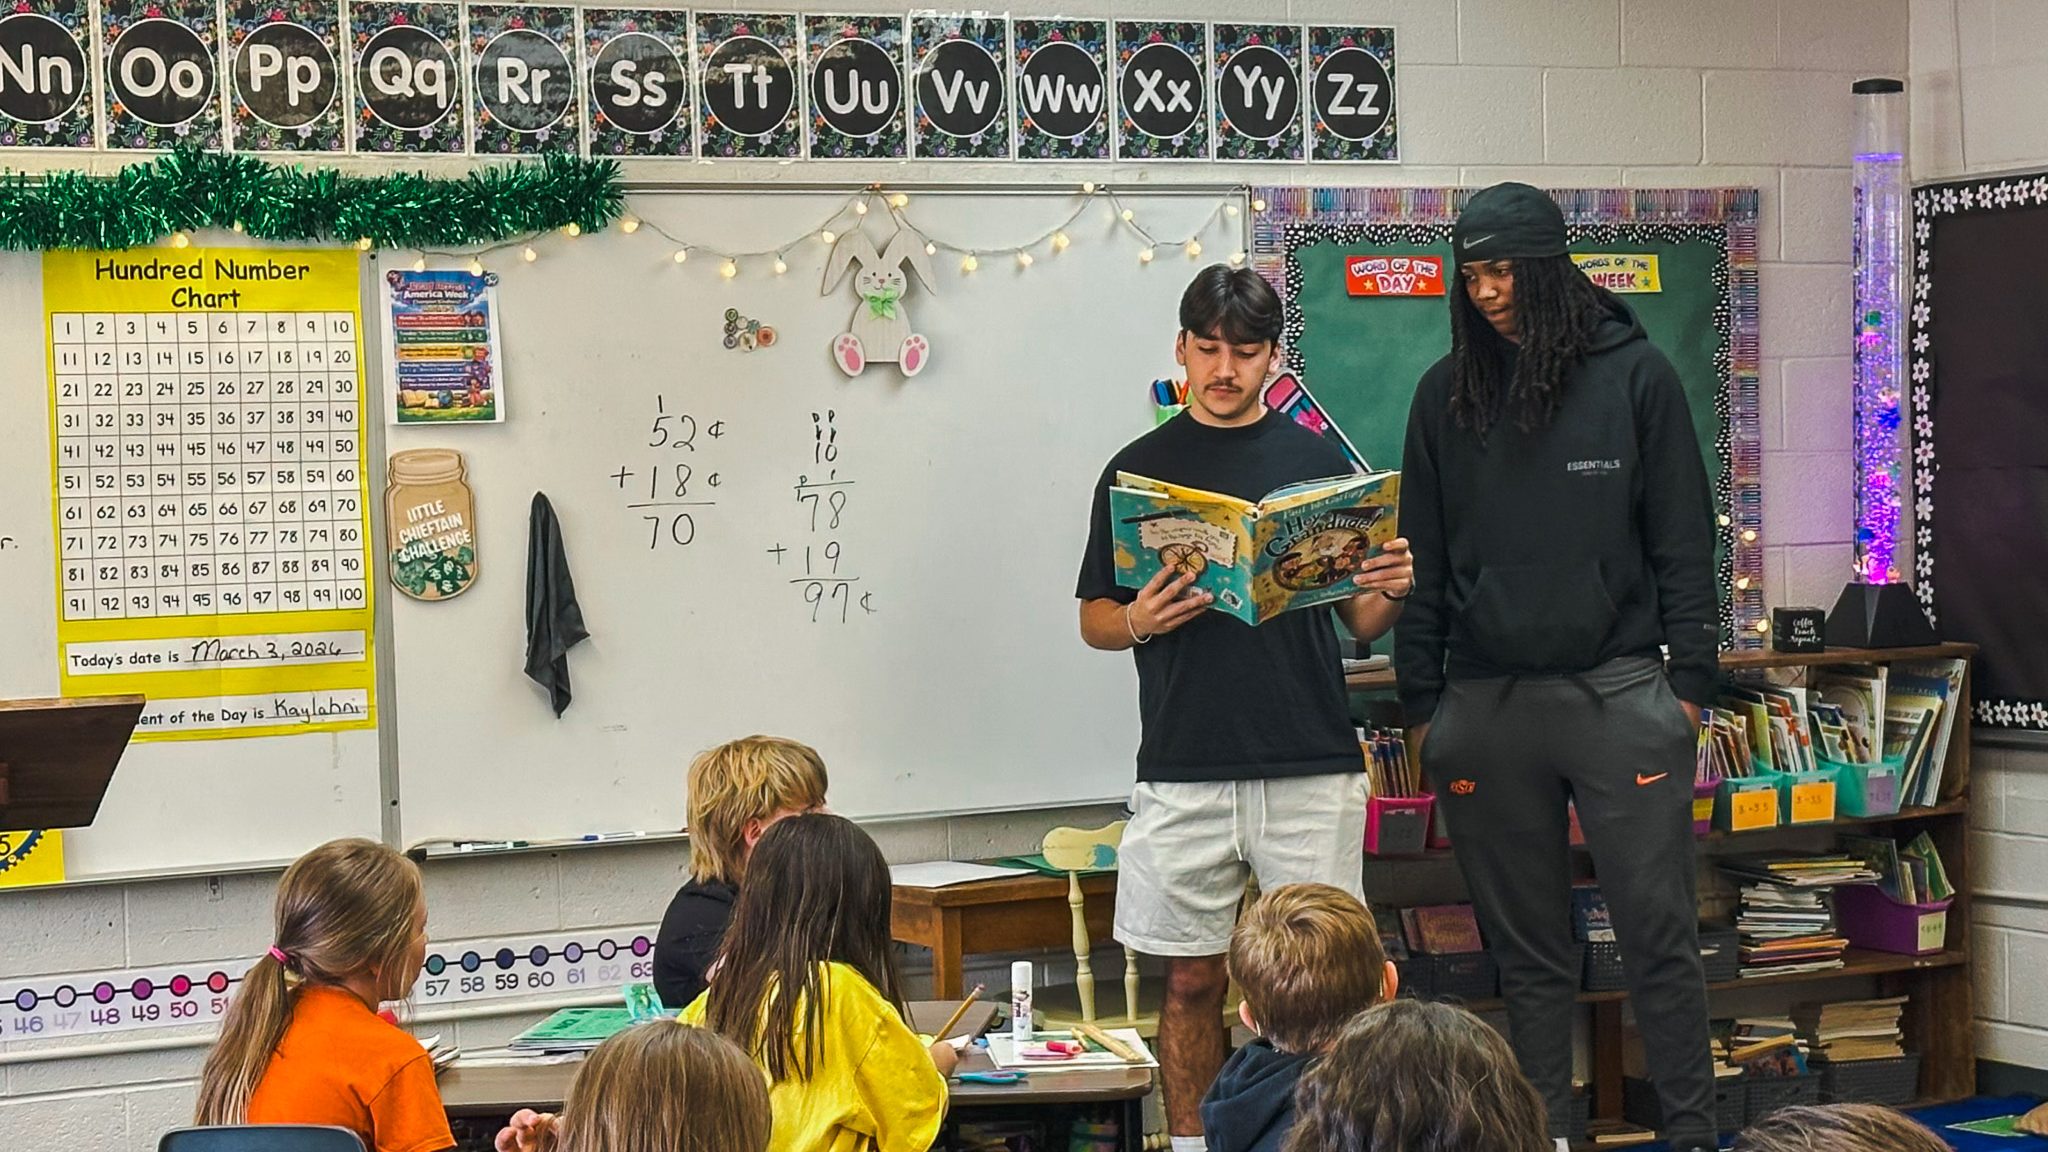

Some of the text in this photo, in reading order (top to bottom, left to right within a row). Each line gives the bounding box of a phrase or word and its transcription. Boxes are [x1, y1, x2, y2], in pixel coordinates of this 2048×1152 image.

[0, 44, 73, 96] Nn
[119, 47, 204, 98] Oo
[248, 43, 322, 107] Pp
[369, 46, 448, 110] Qq
[497, 56, 550, 105] Rr
[609, 59, 668, 107] Ss
[723, 63, 775, 109] Tt
[823, 69, 890, 115] Uu
[931, 68, 990, 114] Vv
[1022, 74, 1101, 116] Ww
[1133, 69, 1194, 113] Xx
[1232, 64, 1285, 120] Yy
[1326, 72, 1380, 116] Zz
[95, 259, 310, 281] Hundred Number
[1352, 259, 1437, 277] WORD OF THE
[1614, 257, 1627, 267] OF
[1632, 259, 1649, 271] THE
[1377, 275, 1415, 292] DAY
[1593, 272, 1637, 289] WEEK
[171, 287, 241, 309] Chart
[66, 320, 349, 335] 1 2 3 4 5 6 7 8 9 10
[63, 350, 351, 366] 11 12 13 14 15 16 17 18 19 20
[62, 380, 353, 397] 21 22 23 24 25 26 27 28 29 30
[64, 409, 354, 428] 31 32 33 34 35 36 37 38 39 40
[64, 439, 354, 459] 41 42 43 44 45 46 47 48 49 50
[816, 442, 838, 464] 10
[1567, 459, 1621, 471] ESSENTIALS
[407, 500, 446, 522] LITTLE
[66, 528, 358, 551] 71 72 73 74 75 76 77 78 79 80
[399, 513, 463, 543] CHIEFTAIN
[643, 513, 695, 549] 70
[400, 529, 471, 562] CHALLENGE
[806, 541, 840, 575] 19
[70, 587, 363, 612] 91 92 93 94 95 96 97 98 99 100
[70, 653, 123, 669] Today's
[129, 651, 161, 665] date
[168, 650, 179, 663] is
[191, 638, 260, 662] March
[170, 712, 185, 724] of
[192, 709, 215, 723] the
[221, 708, 247, 725] Day
[253, 707, 265, 720] is
[426, 979, 450, 996] 57
[461, 977, 485, 993] 58
[496, 974, 518, 989] 59
[528, 972, 555, 987] 60
[568, 967, 585, 983] 61
[598, 964, 622, 981] 62
[15, 1016, 43, 1034] 46
[54, 1012, 81, 1029] 47
[91, 1008, 120, 1026] 48
[132, 1005, 160, 1021] 49
[170, 1001, 198, 1017] 50
